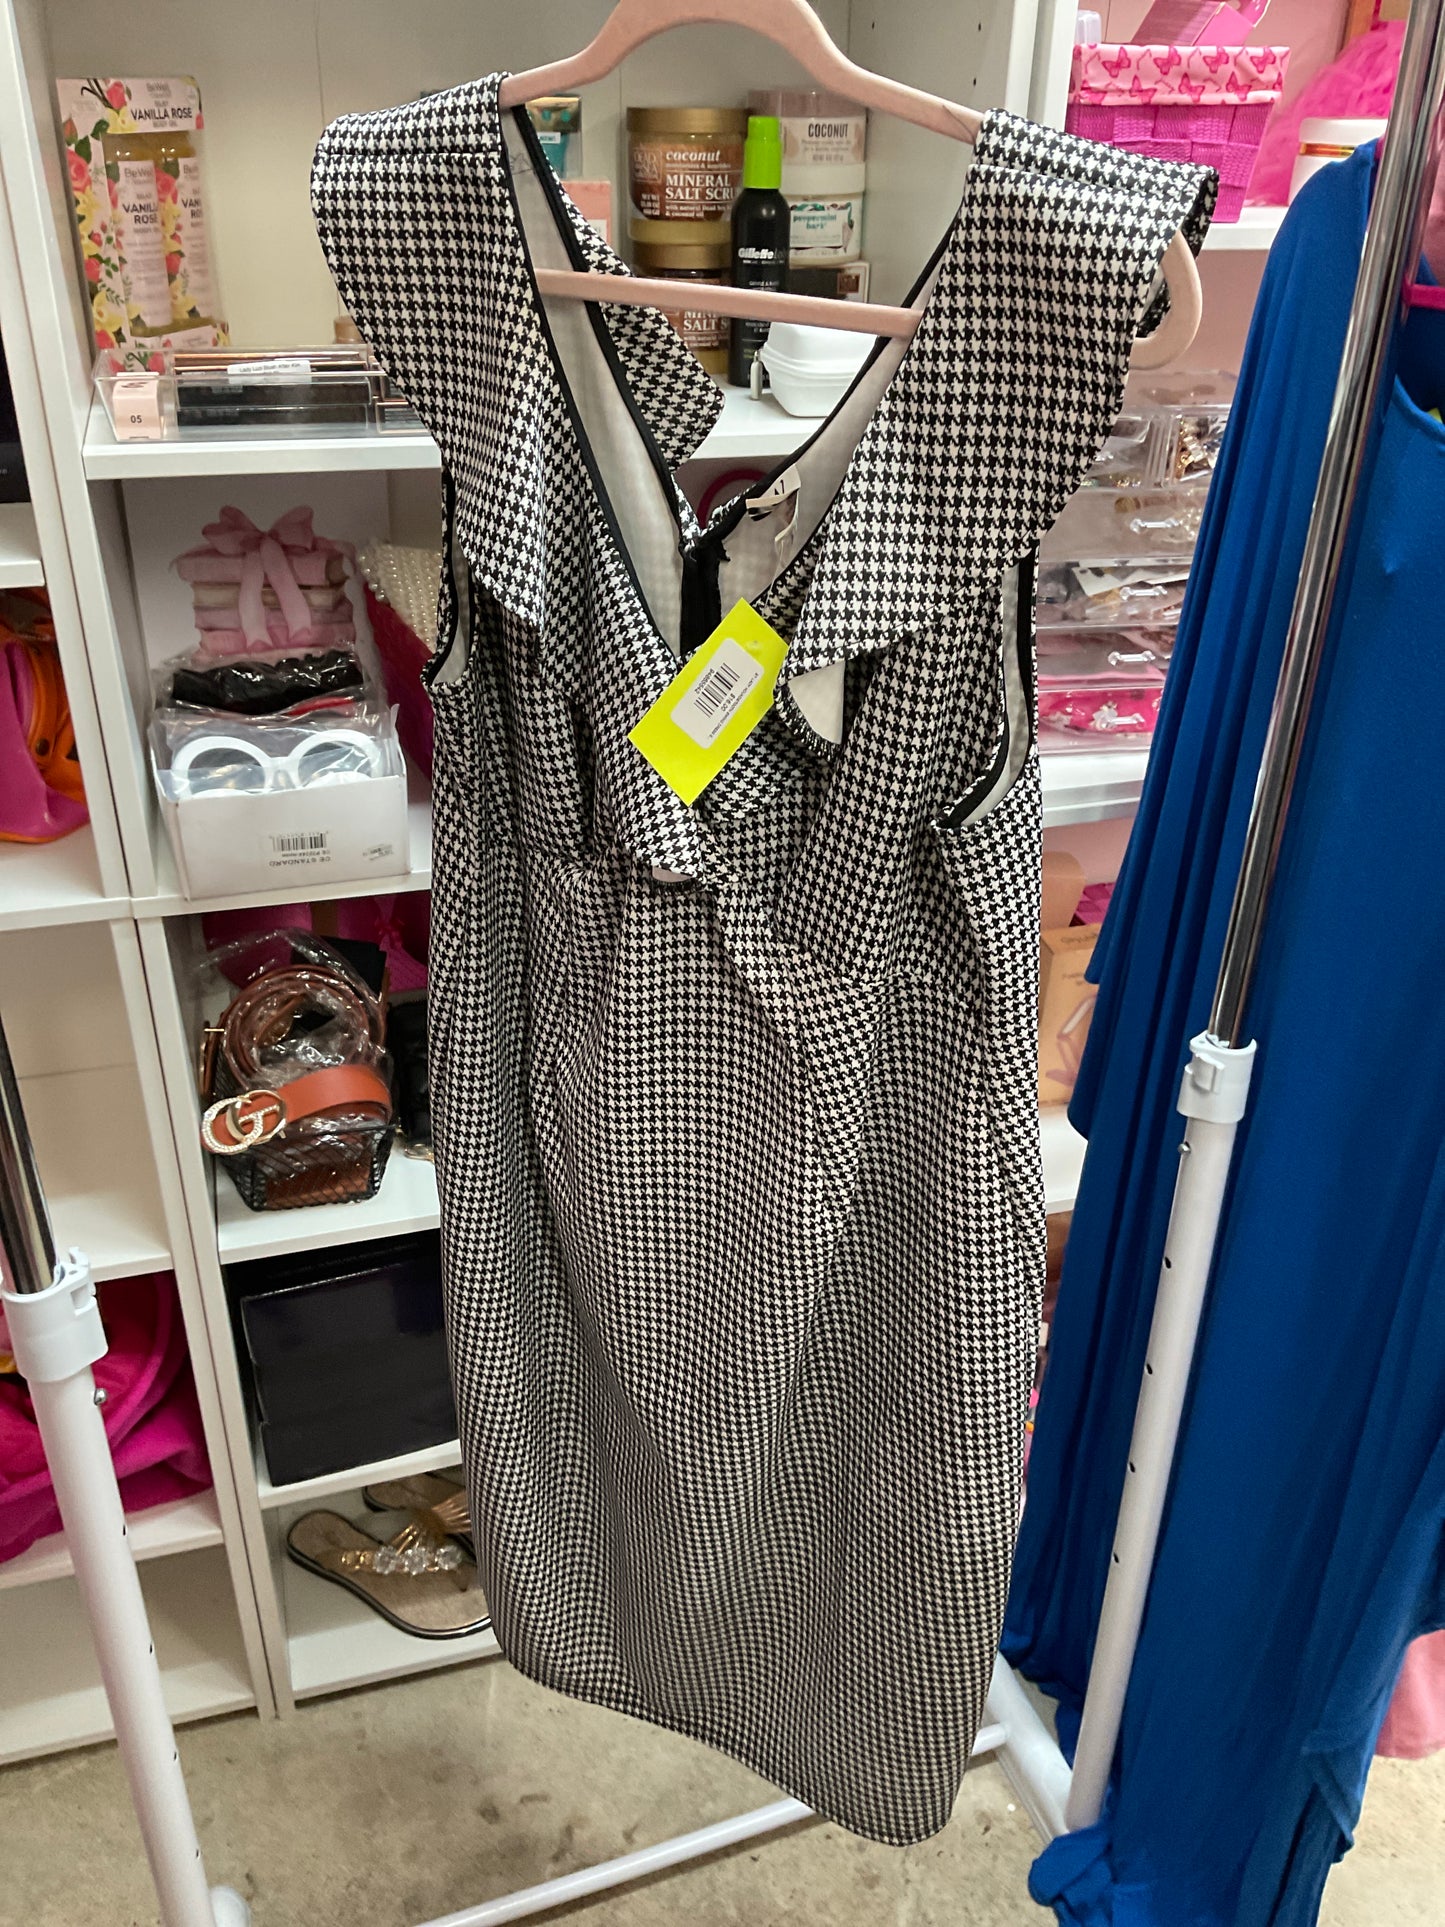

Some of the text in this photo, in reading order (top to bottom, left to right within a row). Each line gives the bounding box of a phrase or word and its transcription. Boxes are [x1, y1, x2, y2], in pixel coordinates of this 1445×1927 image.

[131, 108, 192, 120] VANILLA ROSE
[808, 123, 849, 138] COCONUT
[666, 150, 720, 161] coconut
[666, 174, 732, 187] MINERAL
[665, 187, 702, 200] SALT
[793, 213, 837, 223] peppermint
[683, 318, 718, 330] SALT
[130, 414, 142, 424] 05
[719, 693, 735, 711] $16.00
[268, 855, 316, 867] STANDARD
